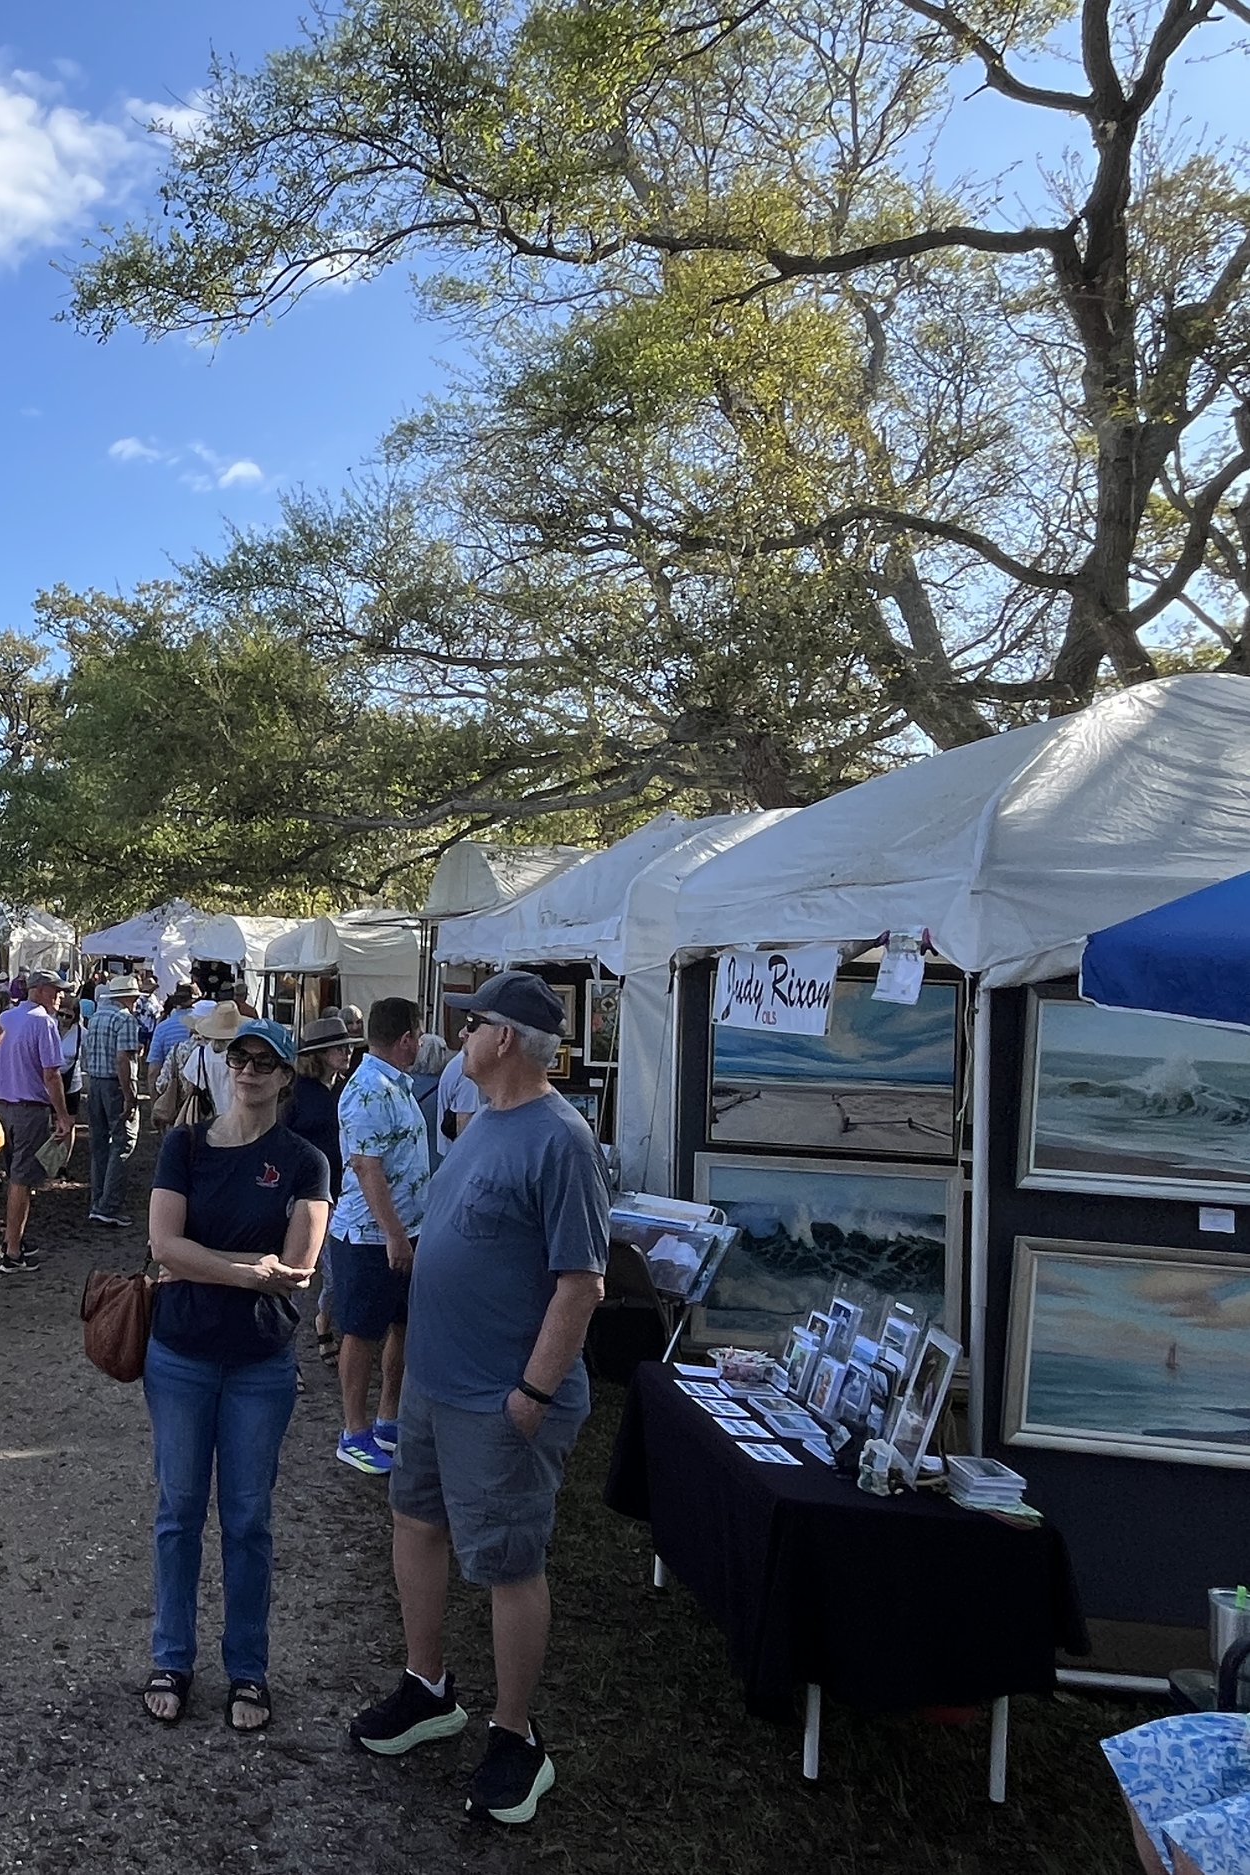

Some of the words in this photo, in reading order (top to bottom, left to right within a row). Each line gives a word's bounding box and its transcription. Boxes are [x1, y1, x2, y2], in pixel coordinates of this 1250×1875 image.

[720, 956, 764, 1022] Judy
[768, 954, 831, 1009] Rixon
[761, 1010, 778, 1026] OILS
